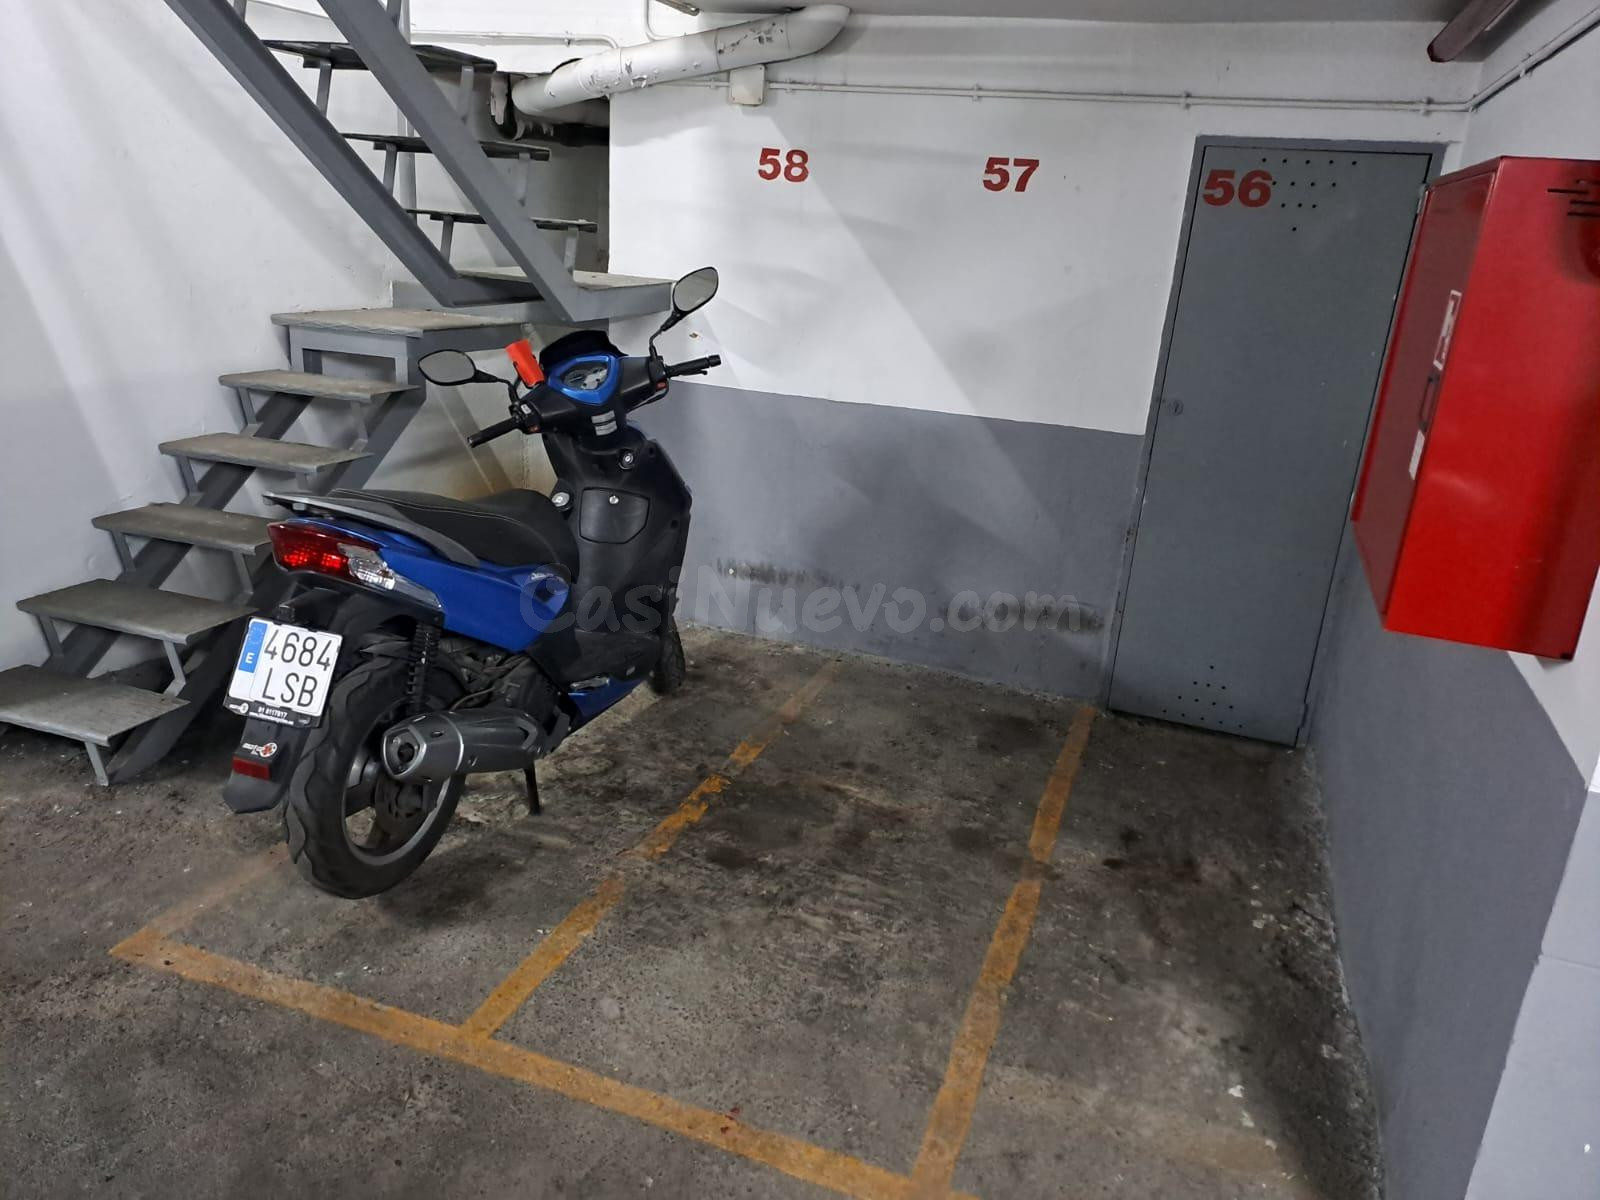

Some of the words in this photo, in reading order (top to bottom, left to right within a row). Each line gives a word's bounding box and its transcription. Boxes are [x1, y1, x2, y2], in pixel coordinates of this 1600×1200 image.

[757, 148, 809, 182] 58
[983, 157, 1040, 192] 57
[1203, 170, 1273, 208] 56
[245, 652, 255, 664] E
[264, 629, 332, 671] 4684
[262, 667, 318, 707] LSB
